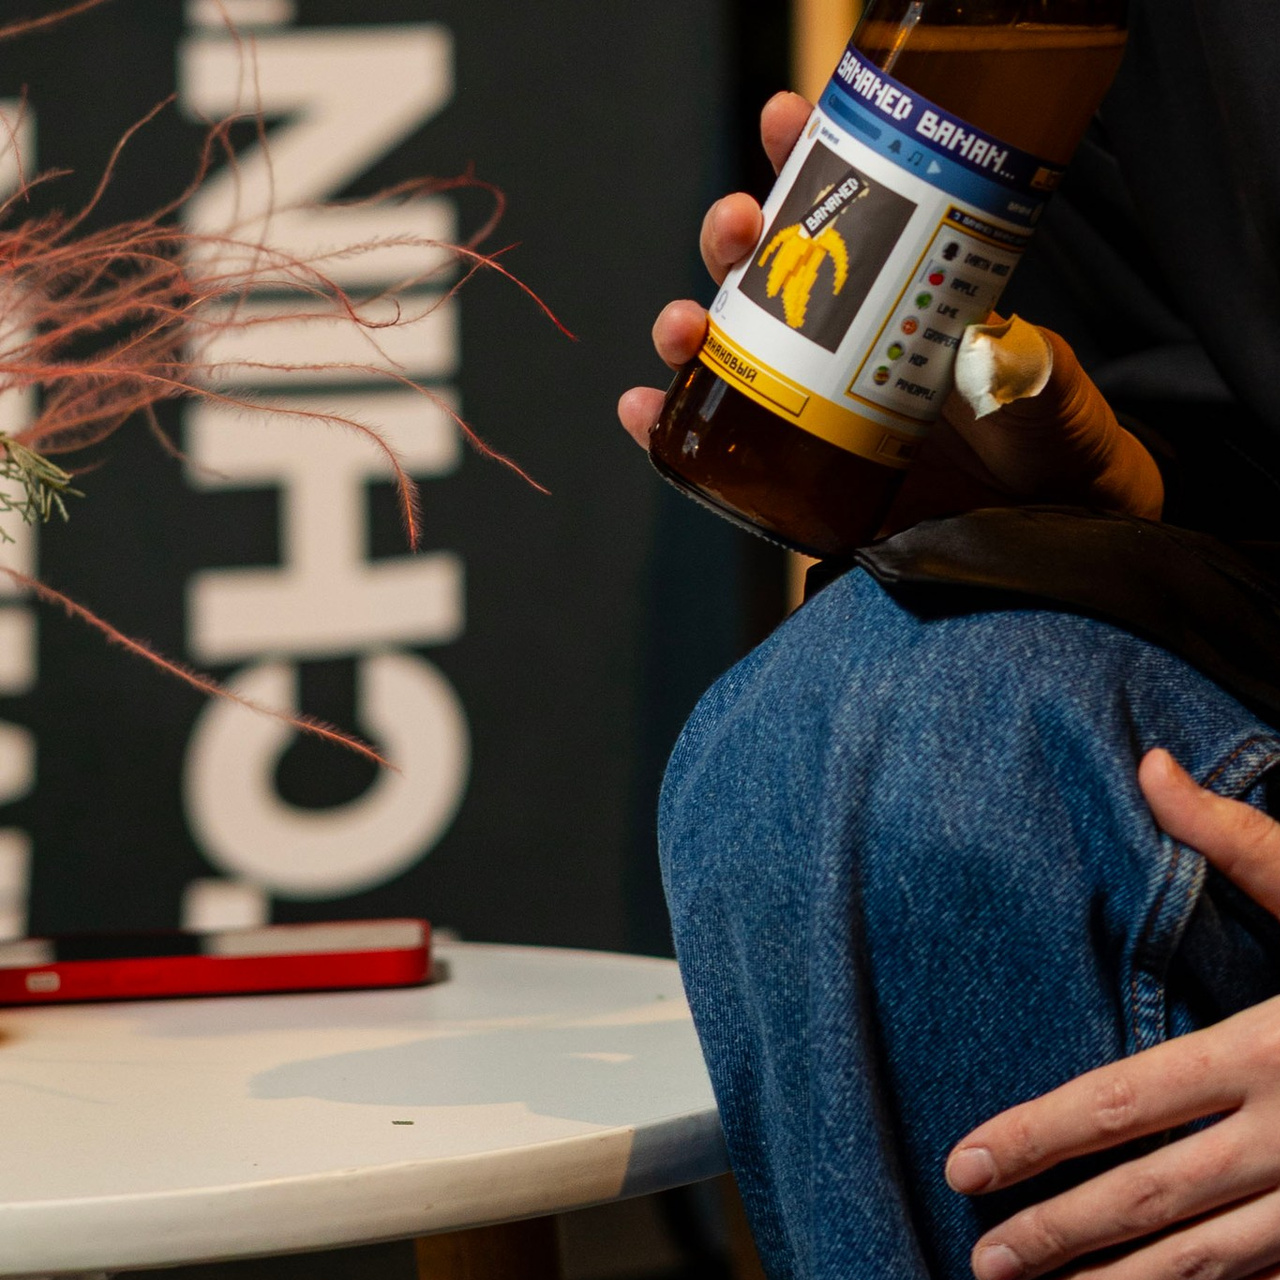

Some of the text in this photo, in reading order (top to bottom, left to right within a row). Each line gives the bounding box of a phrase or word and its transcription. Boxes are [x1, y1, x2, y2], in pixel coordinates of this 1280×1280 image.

[836, 50, 913, 120] BANANED
[804, 176, 860, 232] BANANED
[936, 302, 960, 319] LIME
[908, 352, 929, 368] HOP
[894, 377, 937, 402] PINEAPPLE
